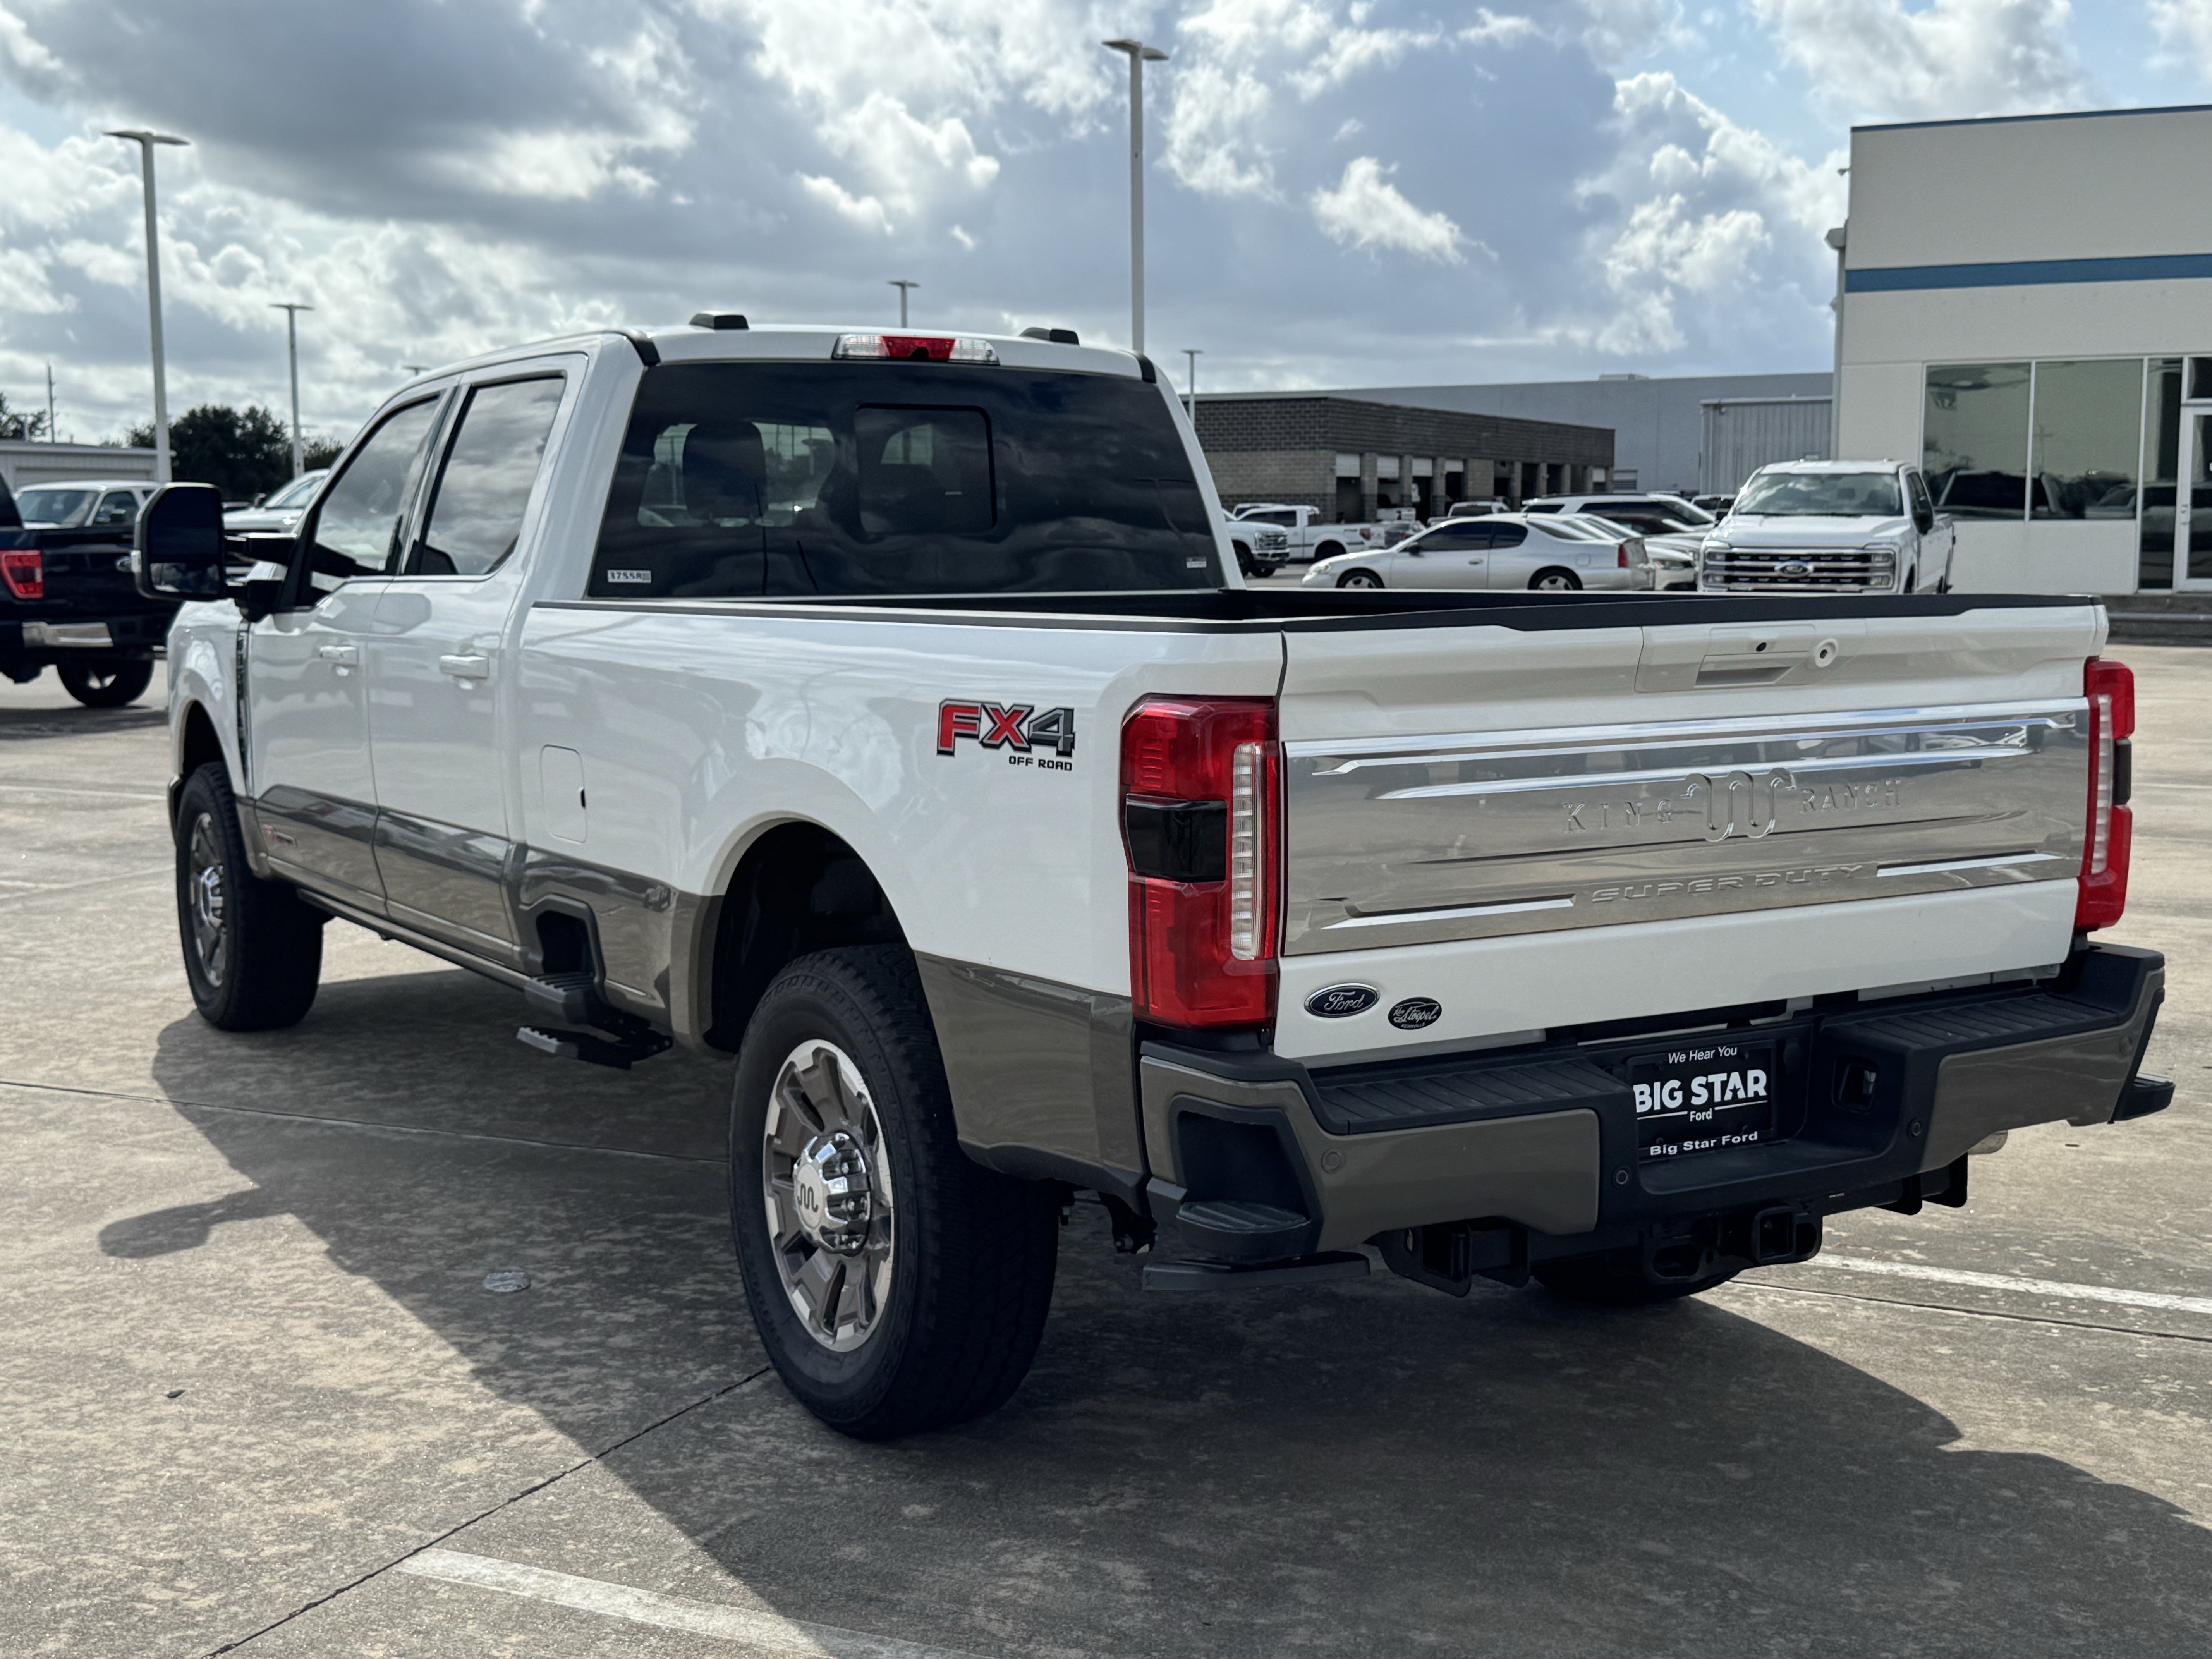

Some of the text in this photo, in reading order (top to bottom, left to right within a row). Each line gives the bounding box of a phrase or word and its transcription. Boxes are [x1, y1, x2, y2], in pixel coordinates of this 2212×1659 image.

[936, 697, 1076, 757] FX4
[1008, 756, 1073, 771] OFF ROAD
[1562, 779, 1901, 834] KING RANCH
[1592, 864, 1863, 903] SUPER DUTY
[1324, 991, 1365, 1011] Ford
[1668, 1046, 1738, 1064] We Hear You
[1633, 1069, 1767, 1113] BIG STAR
[1690, 1108, 1712, 1122] Ford
[1650, 1131, 1758, 1156] Big Star Ford
